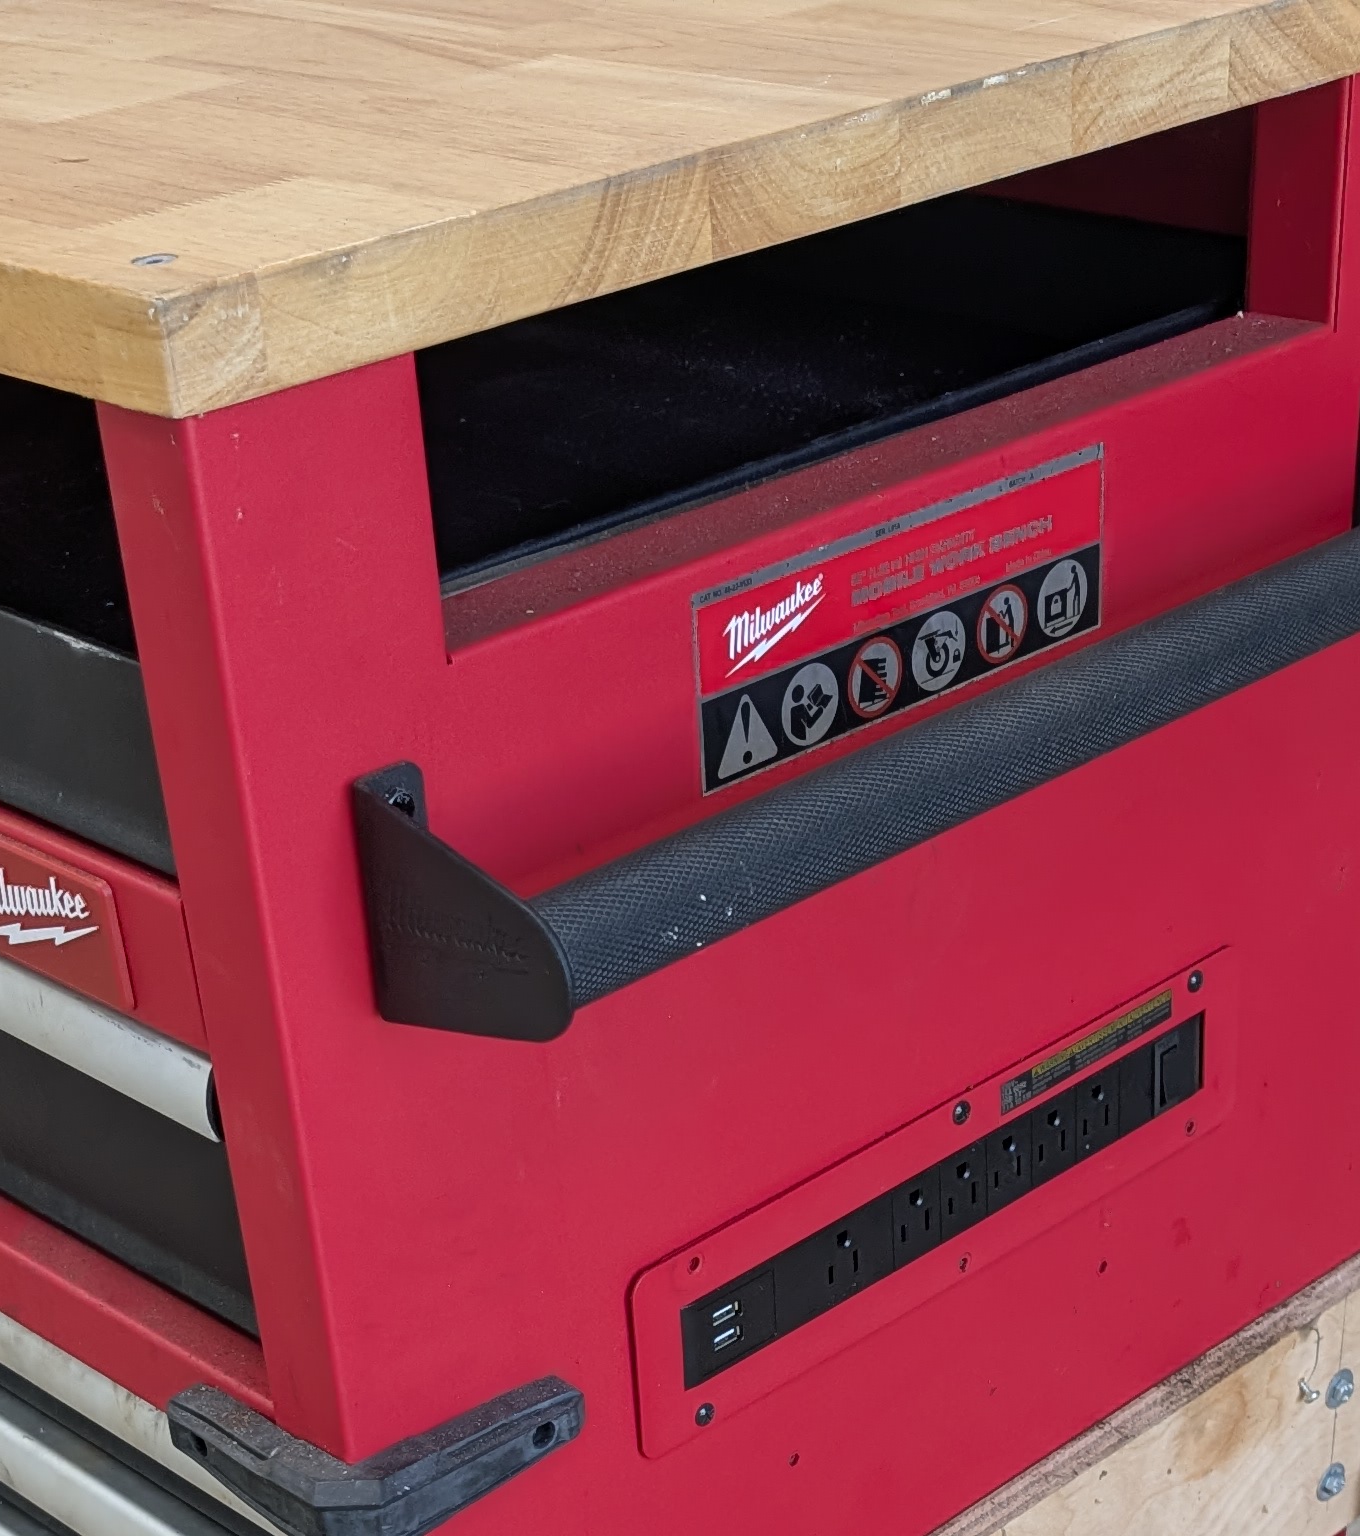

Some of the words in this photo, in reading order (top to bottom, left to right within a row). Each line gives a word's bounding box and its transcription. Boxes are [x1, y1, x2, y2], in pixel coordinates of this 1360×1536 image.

[699, 592, 712, 604] CAT
[850, 563, 925, 608] MOBILE
[929, 541, 986, 577] WORK
[989, 514, 1053, 555] BENCH
[722, 574, 823, 661] Milwaukee
